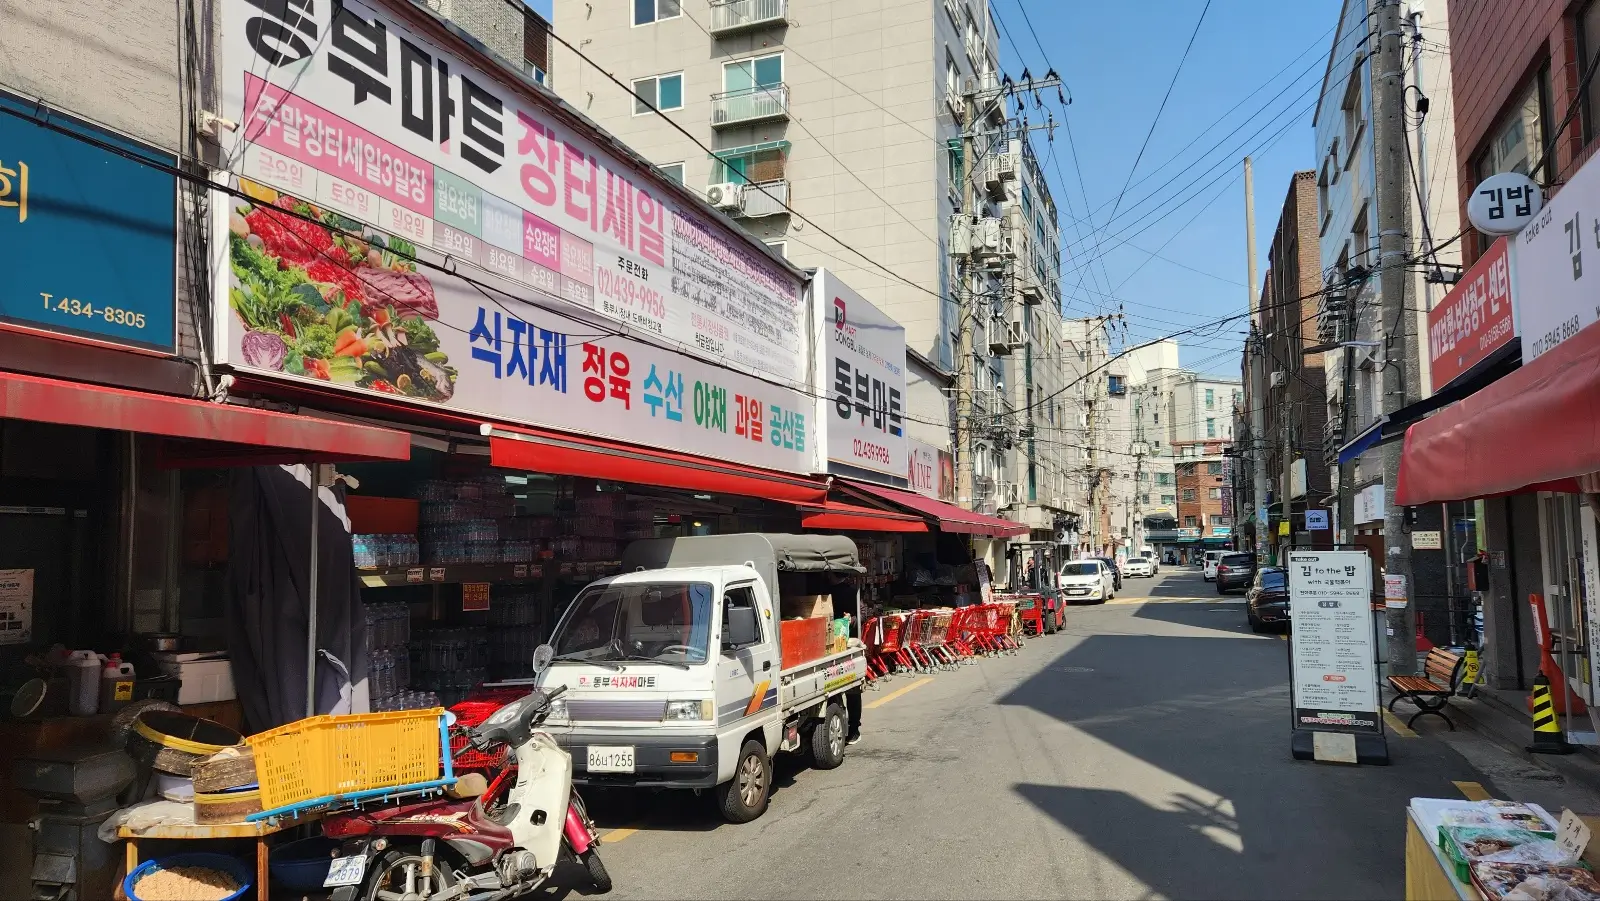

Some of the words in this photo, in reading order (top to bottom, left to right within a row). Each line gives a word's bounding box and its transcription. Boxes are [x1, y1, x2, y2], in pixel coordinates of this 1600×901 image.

[245, 0, 505, 174] 동부마트
[516, 109, 665, 268] 장터세일
[256, 92, 427, 204] 주말장터세일3일장
[258, 151, 303, 189] 금요일
[332, 181, 369, 213] 토요일
[392, 208, 425, 238] 일요일
[437, 179, 477, 225] 월요장터
[525, 223, 557, 262] 수요장터
[1480, 185, 1533, 220] 김밥
[1525, 222, 1539, 244] take
[1541, 207, 1552, 229] out
[1565, 211, 1582, 281] 김
[443, 227, 473, 258] 월요일
[489, 249, 516, 275] 화요일
[531, 266, 554, 289] 수요일
[568, 281, 589, 303] 목요일
[618, 256, 648, 281] 주문전화
[1489, 251, 1509, 316] 센터
[40, 292, 146, 329] T.434-8305
[598, 266, 666, 320] 02)439-9956
[835, 330, 857, 353] DONGBU
[1532, 339, 1542, 358] 010
[1544, 330, 1561, 351] 5945
[469, 306, 567, 394] 식자재
[582, 341, 631, 411] 정육
[643, 363, 685, 423] 수산
[693, 380, 727, 434] 야채
[734, 394, 763, 443] 과일
[769, 404, 805, 453] 공산품
[835, 357, 902, 437] 동부마트
[853, 438, 890, 465] 02.439.9956
[1301, 566, 1311, 576] 김
[1344, 566, 1356, 576] 밥
[593, 676, 656, 688] 동부식자재마트
